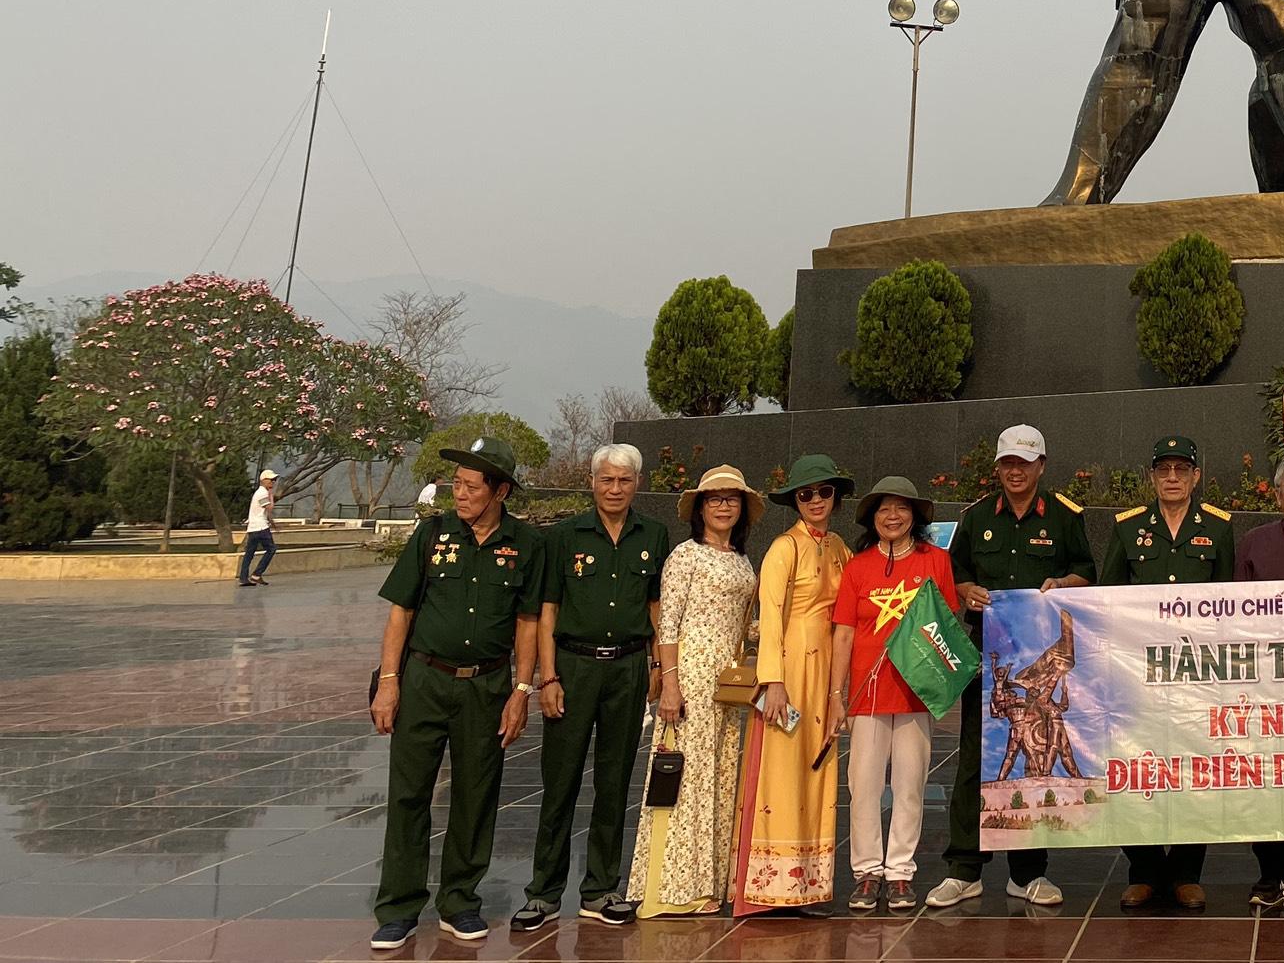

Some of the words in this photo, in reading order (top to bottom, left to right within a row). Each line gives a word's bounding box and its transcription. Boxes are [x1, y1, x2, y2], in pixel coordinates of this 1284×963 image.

[1159, 597, 1192, 623] HỘI
[1197, 597, 1236, 622] CỰU
[1144, 635, 1260, 684] HÀNH
[1208, 693, 1253, 738] KỶ
[1105, 750, 1183, 800] ĐIỆN
[1190, 748, 1264, 791] BIÊN
